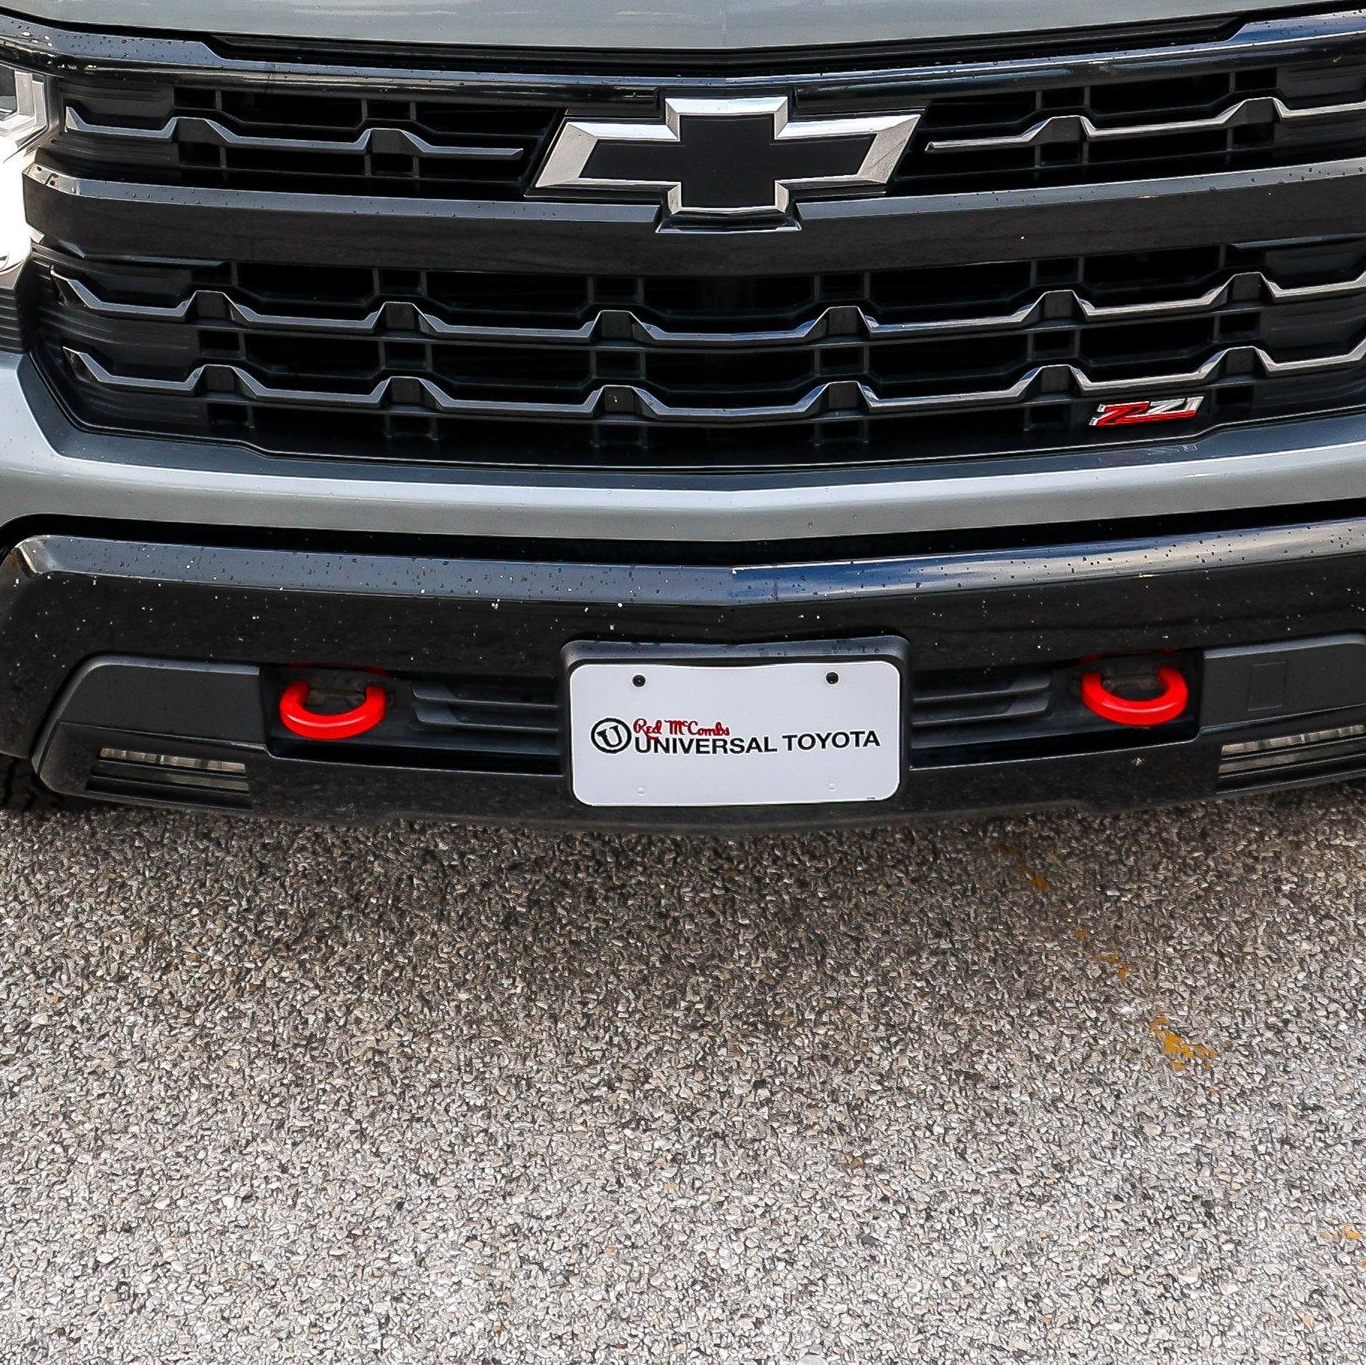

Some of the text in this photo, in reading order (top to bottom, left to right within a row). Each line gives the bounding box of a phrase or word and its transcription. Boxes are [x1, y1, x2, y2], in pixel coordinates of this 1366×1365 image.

[1089, 396, 1204, 428] Z71
[633, 718, 730, 741] Red McCombs
[635, 730, 881, 755] UNIVERSAL TOYOTA
